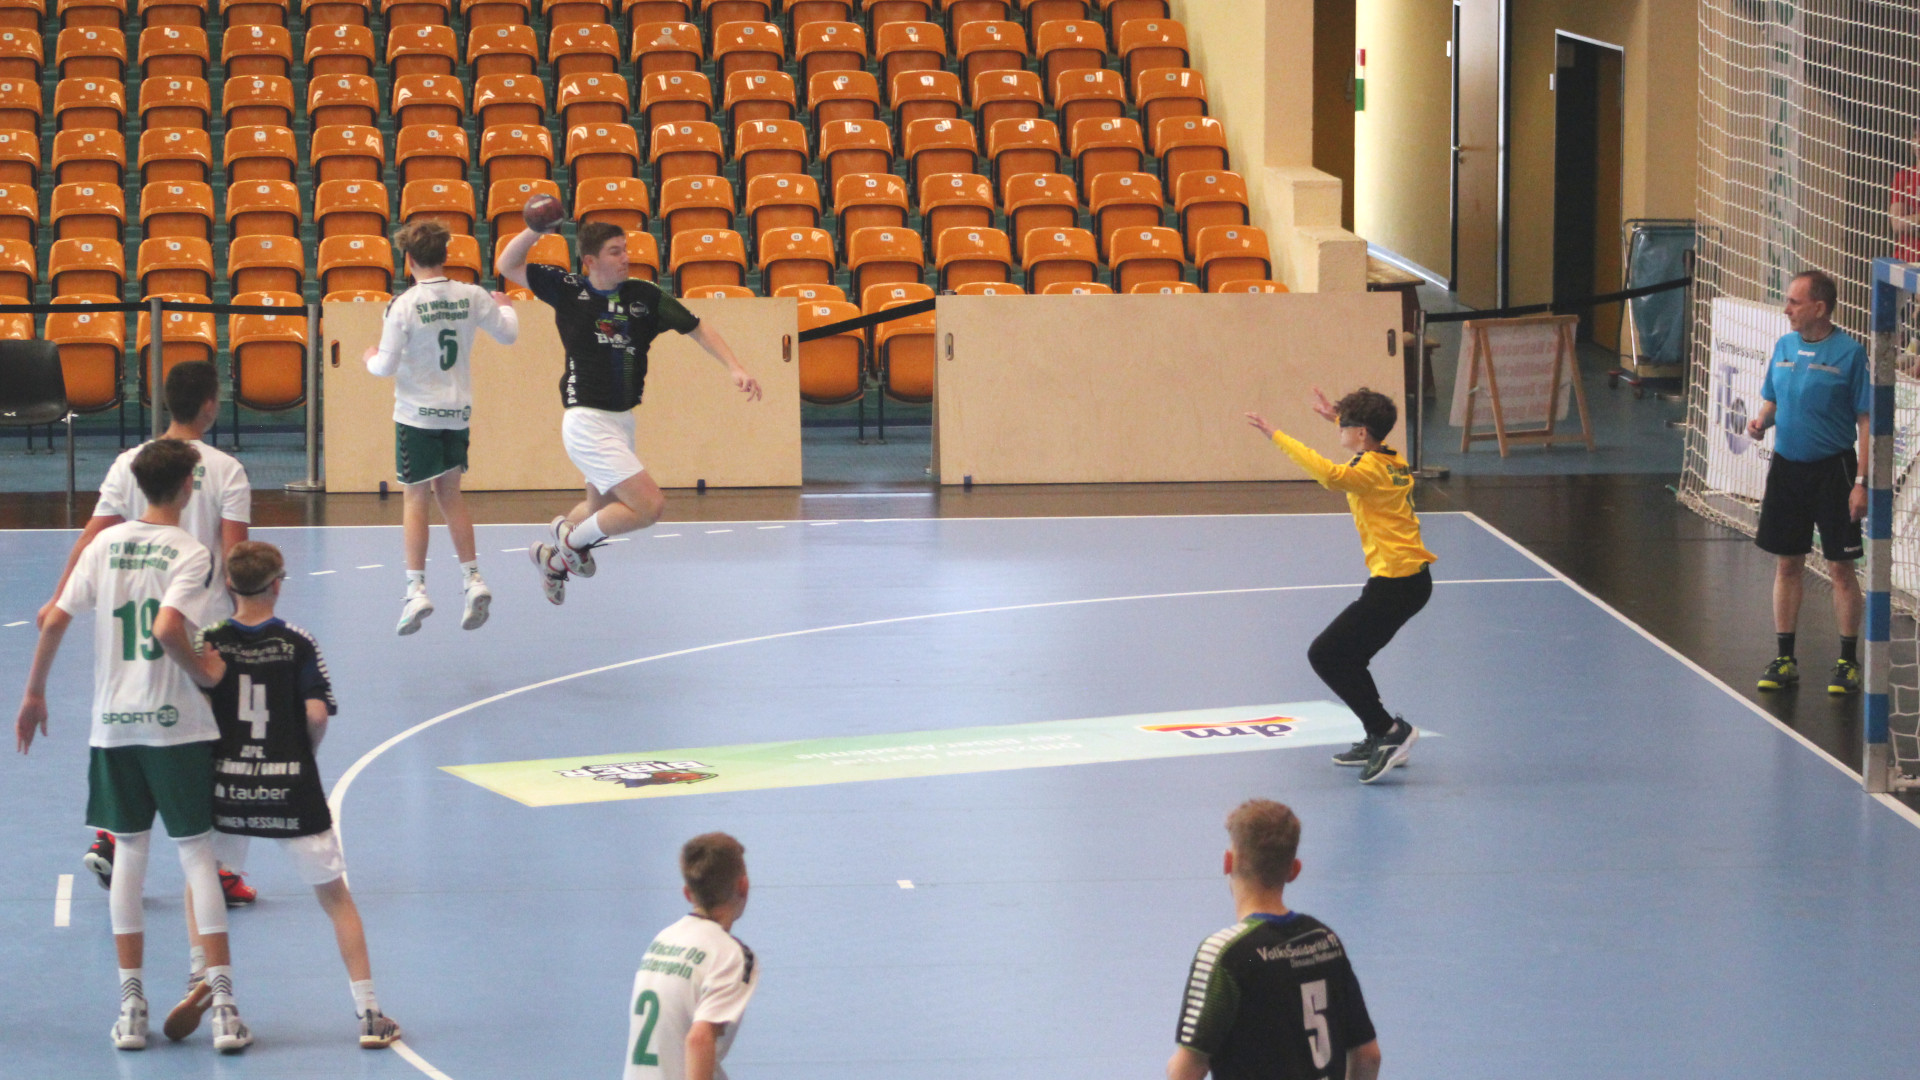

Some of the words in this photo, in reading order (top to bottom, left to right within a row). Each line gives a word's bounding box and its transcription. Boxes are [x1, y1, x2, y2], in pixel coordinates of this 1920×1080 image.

[416, 302, 428, 314] SV
[459, 298, 470, 308] 09
[438, 328, 458, 371] 5
[1716, 338, 1766, 365] Vermessung
[419, 407, 461, 418] SPORT
[162, 545, 178, 560] 09
[113, 598, 164, 661] 19
[238, 675, 270, 740] 4
[102, 712, 155, 724] SPORT
[1179, 724, 1292, 738] dm
[558, 760, 706, 777] BIBER
[228, 784, 290, 800] tauber
[685, 946, 706, 965] 09
[632, 989, 660, 1066] 2
[1300, 979, 1332, 1070] 5
